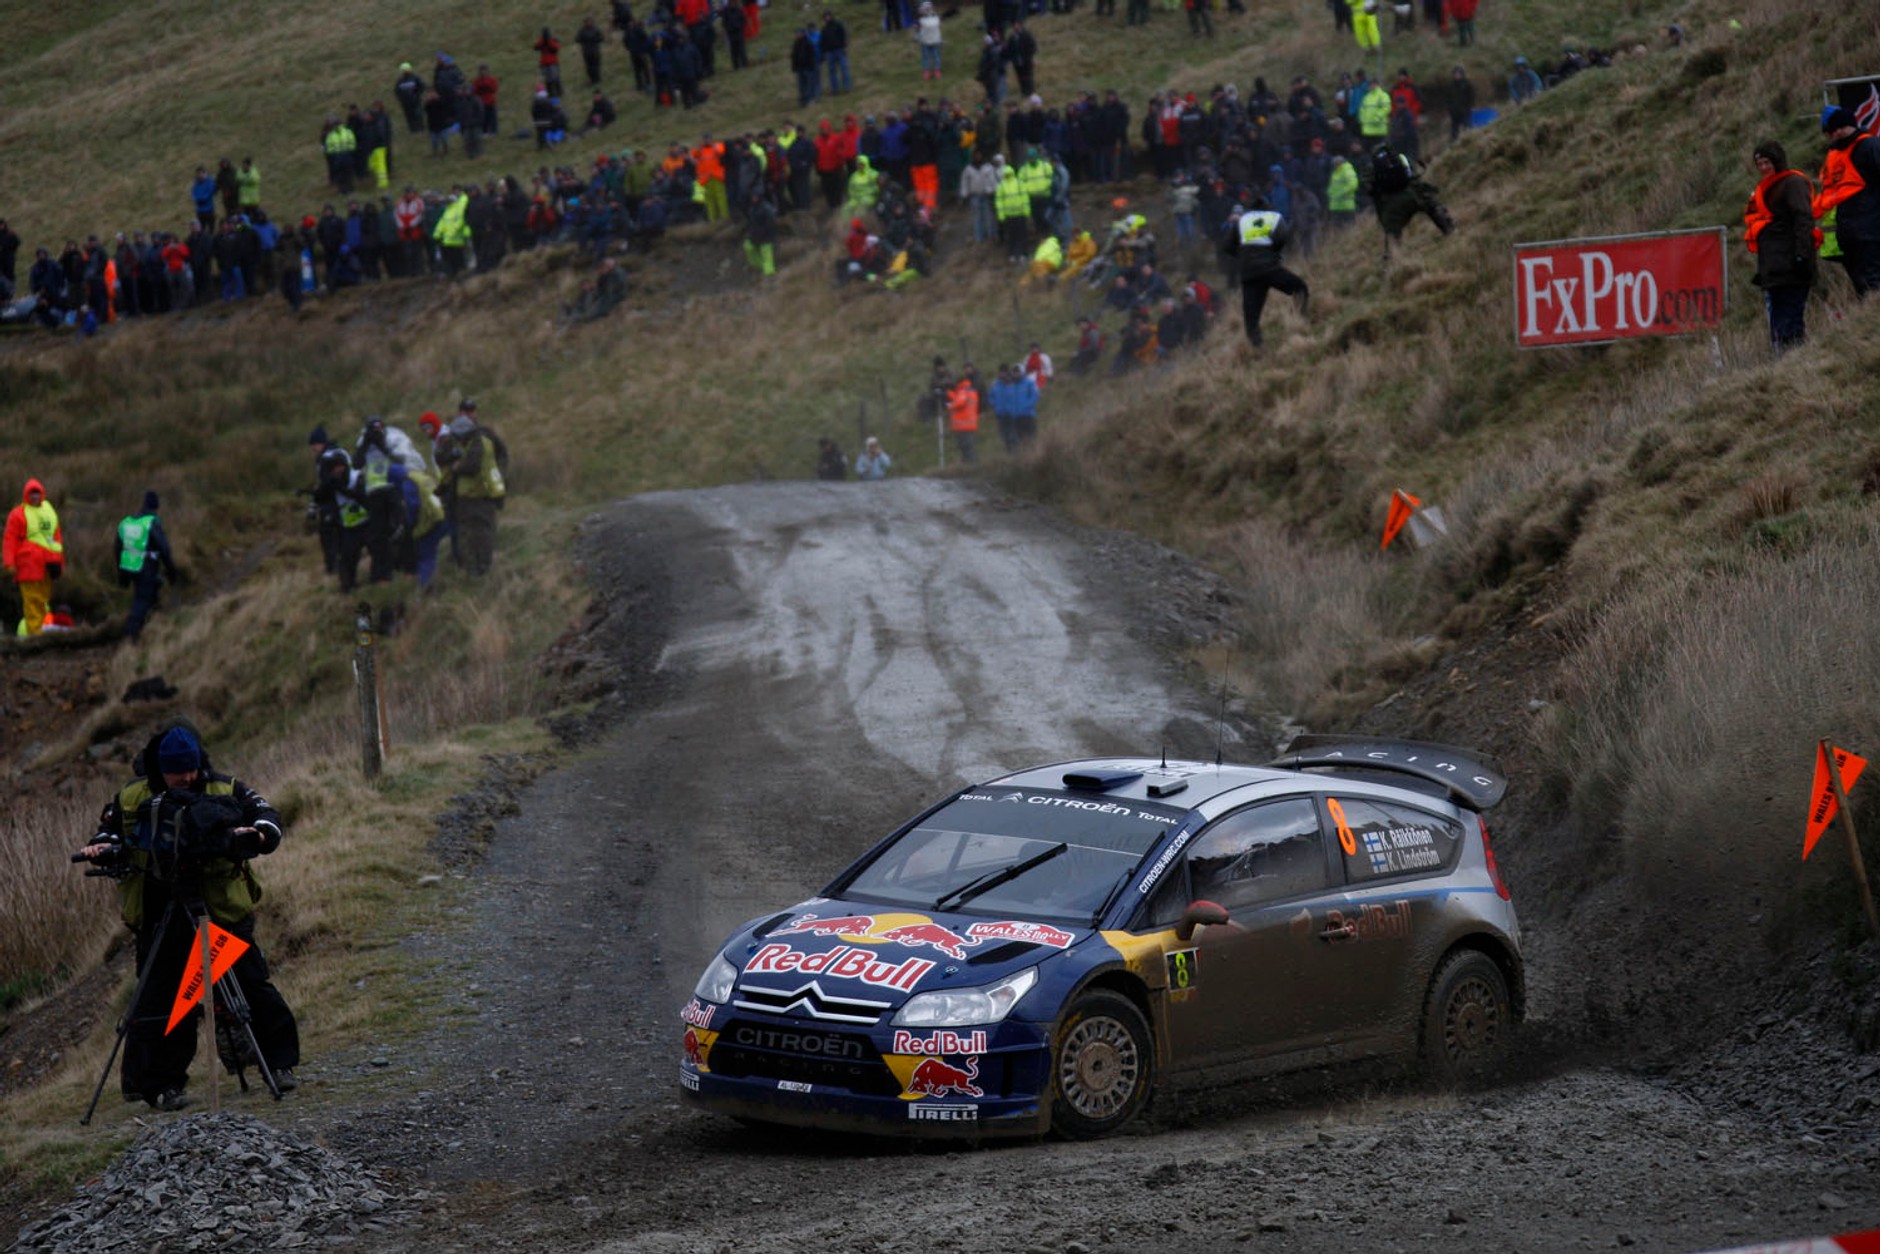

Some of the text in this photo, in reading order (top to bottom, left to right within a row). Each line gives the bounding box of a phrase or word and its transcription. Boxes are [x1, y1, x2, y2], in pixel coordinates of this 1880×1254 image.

[1520, 251, 1718, 337] FxPro.com
[958, 793, 994, 801] TOTAL
[1027, 796, 1131, 816] CITROËN
[1813, 793, 1832, 823] WALES
[1138, 811, 1179, 825] TOTAL
[1327, 797, 1357, 856] 8
[1379, 831, 1392, 850] K.
[1139, 830, 1190, 893] CITROEN-WRC.COM
[1386, 847, 1440, 871] K. Lindström
[216, 934, 228, 948] GB
[975, 925, 1033, 938] WALES
[743, 943, 937, 994] Red Bull
[1175, 953, 1189, 988] 8
[735, 1027, 863, 1058] CITROËN
[893, 1030, 987, 1055] Red Bull
[908, 1103, 979, 1120] PIRELLI
